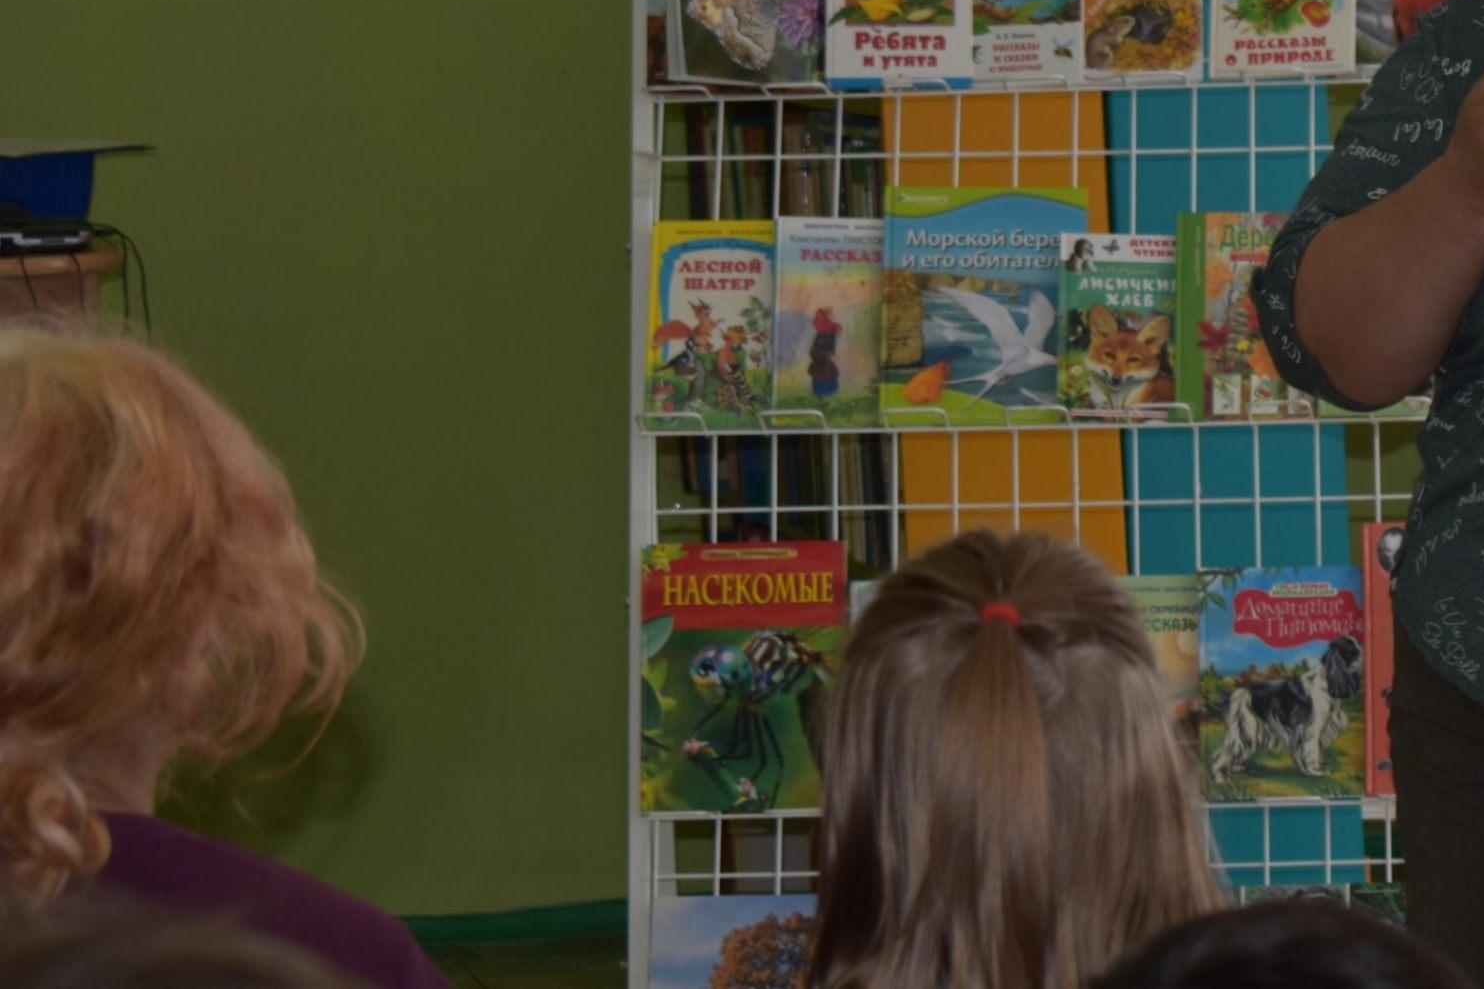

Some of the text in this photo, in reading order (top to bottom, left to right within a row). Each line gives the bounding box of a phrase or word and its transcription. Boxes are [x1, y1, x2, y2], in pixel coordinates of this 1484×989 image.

[854, 31, 946, 51] Ребята
[880, 55, 939, 71] утята
[906, 228, 1061, 253] Морской бере
[800, 248, 883, 263] РАССКАЗ
[901, 249, 1061, 270] и его обитател
[679, 258, 763, 274] ЛЕСНОЙ
[1104, 293, 1155, 308] ХЛЕБ
[662, 571, 834, 607] НАСЕКОМЫЕ
